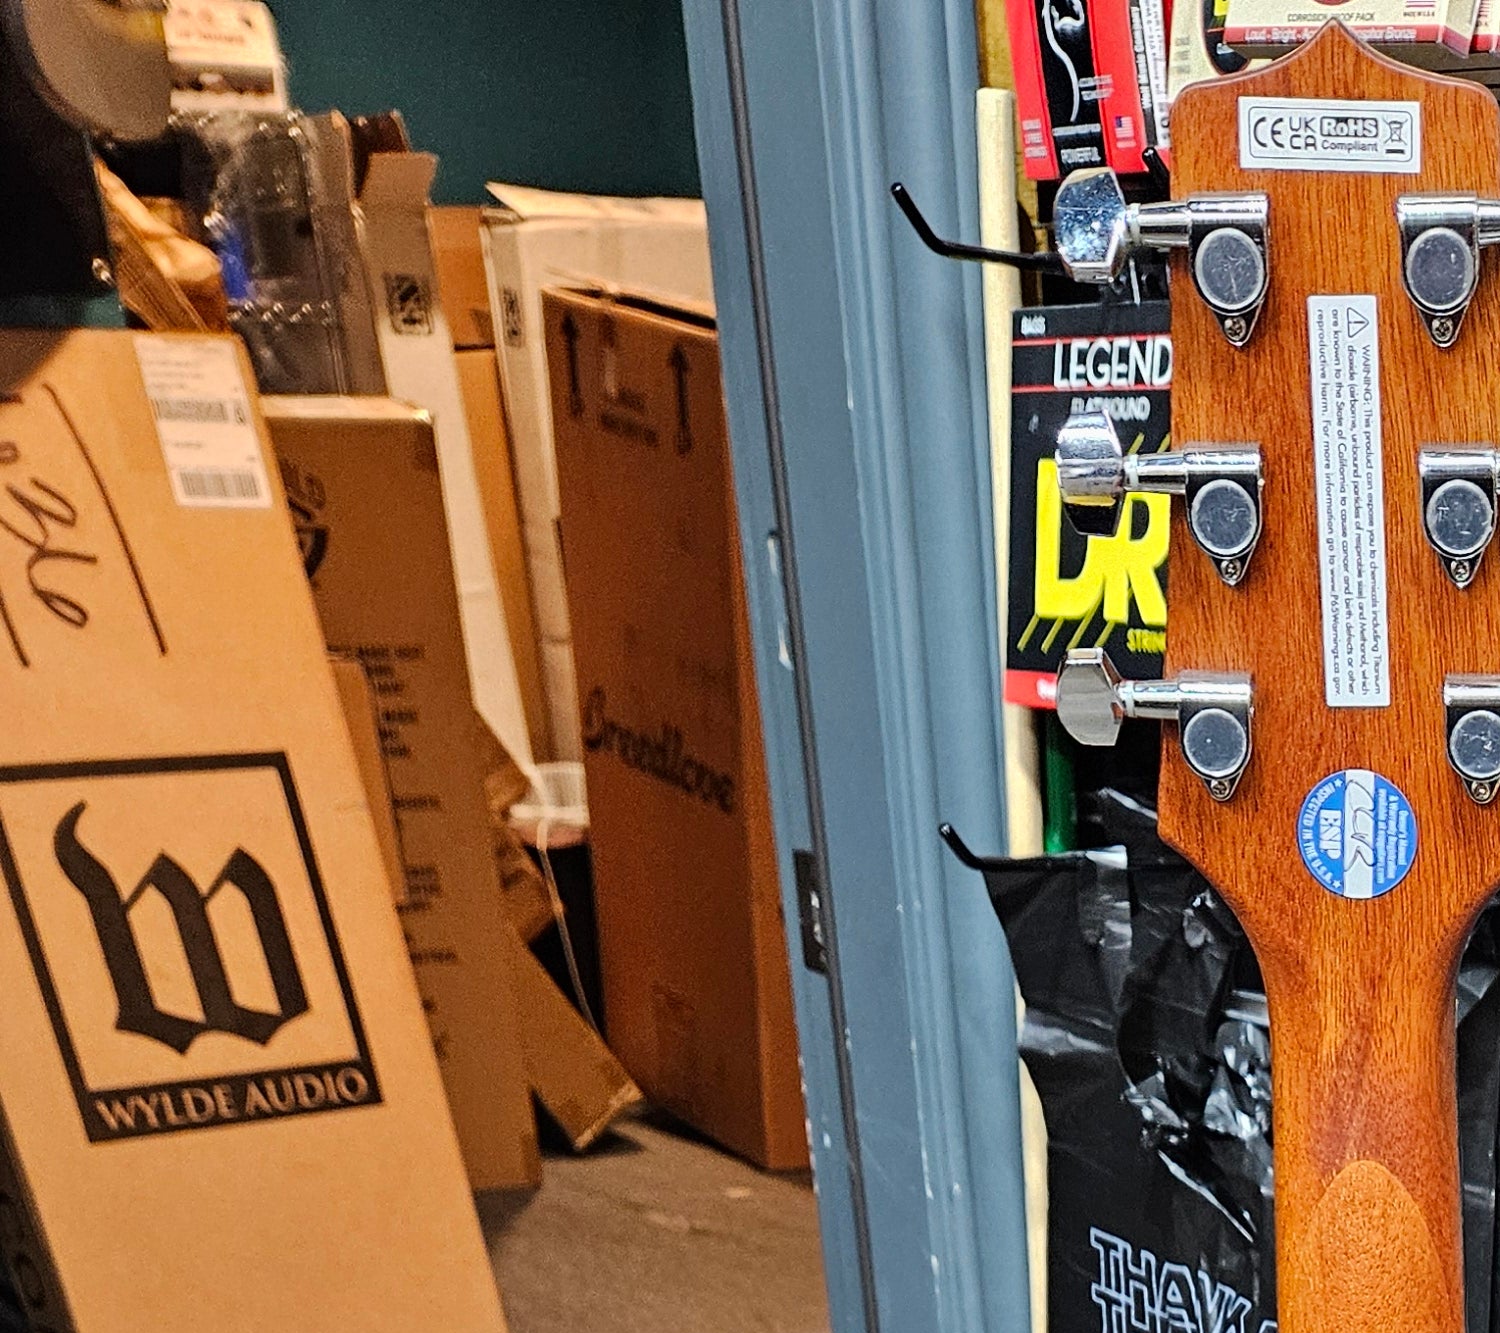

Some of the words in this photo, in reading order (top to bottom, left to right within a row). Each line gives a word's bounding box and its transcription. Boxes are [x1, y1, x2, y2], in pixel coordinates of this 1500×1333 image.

[1290, 116, 1315, 133] UK
[1320, 118, 1378, 138] RoHS
[1290, 134, 1318, 152] CA
[1321, 139, 1378, 153] Compliant
[1316, 309, 1327, 379] reproductive
[1333, 330, 1343, 366] known
[1054, 337, 1172, 388] LEGEND
[1361, 345, 1373, 405] WARNING:
[1320, 383, 1330, 415] harm.
[1335, 382, 1344, 398] the
[1336, 401, 1345, 426] State
[1364, 409, 1373, 428] This
[1322, 420, 1331, 438] For
[1323, 441, 1331, 469] more
[1363, 431, 1373, 469] product
[1337, 443, 1347, 493] California
[1325, 473, 1337, 534] information
[1340, 509, 1349, 537] cause
[1351, 434, 1360, 478] unbound
[1357, 602, 1366, 620] and
[1367, 530, 1376, 547] you
[1341, 540, 1351, 573] cancer
[1344, 576, 1353, 594] and
[1370, 562, 1380, 608] chemicals
[1345, 597, 1354, 619] birth
[1345, 622, 1355, 655] defects
[1371, 610, 1382, 652] including
[1347, 670, 1356, 695] other
[1303, 783, 1335, 827] INSPECTED
[1302, 829, 1313, 840] IN
[97, 1084, 234, 1131] WYLDE
[244, 1067, 369, 1116] AUDIO
